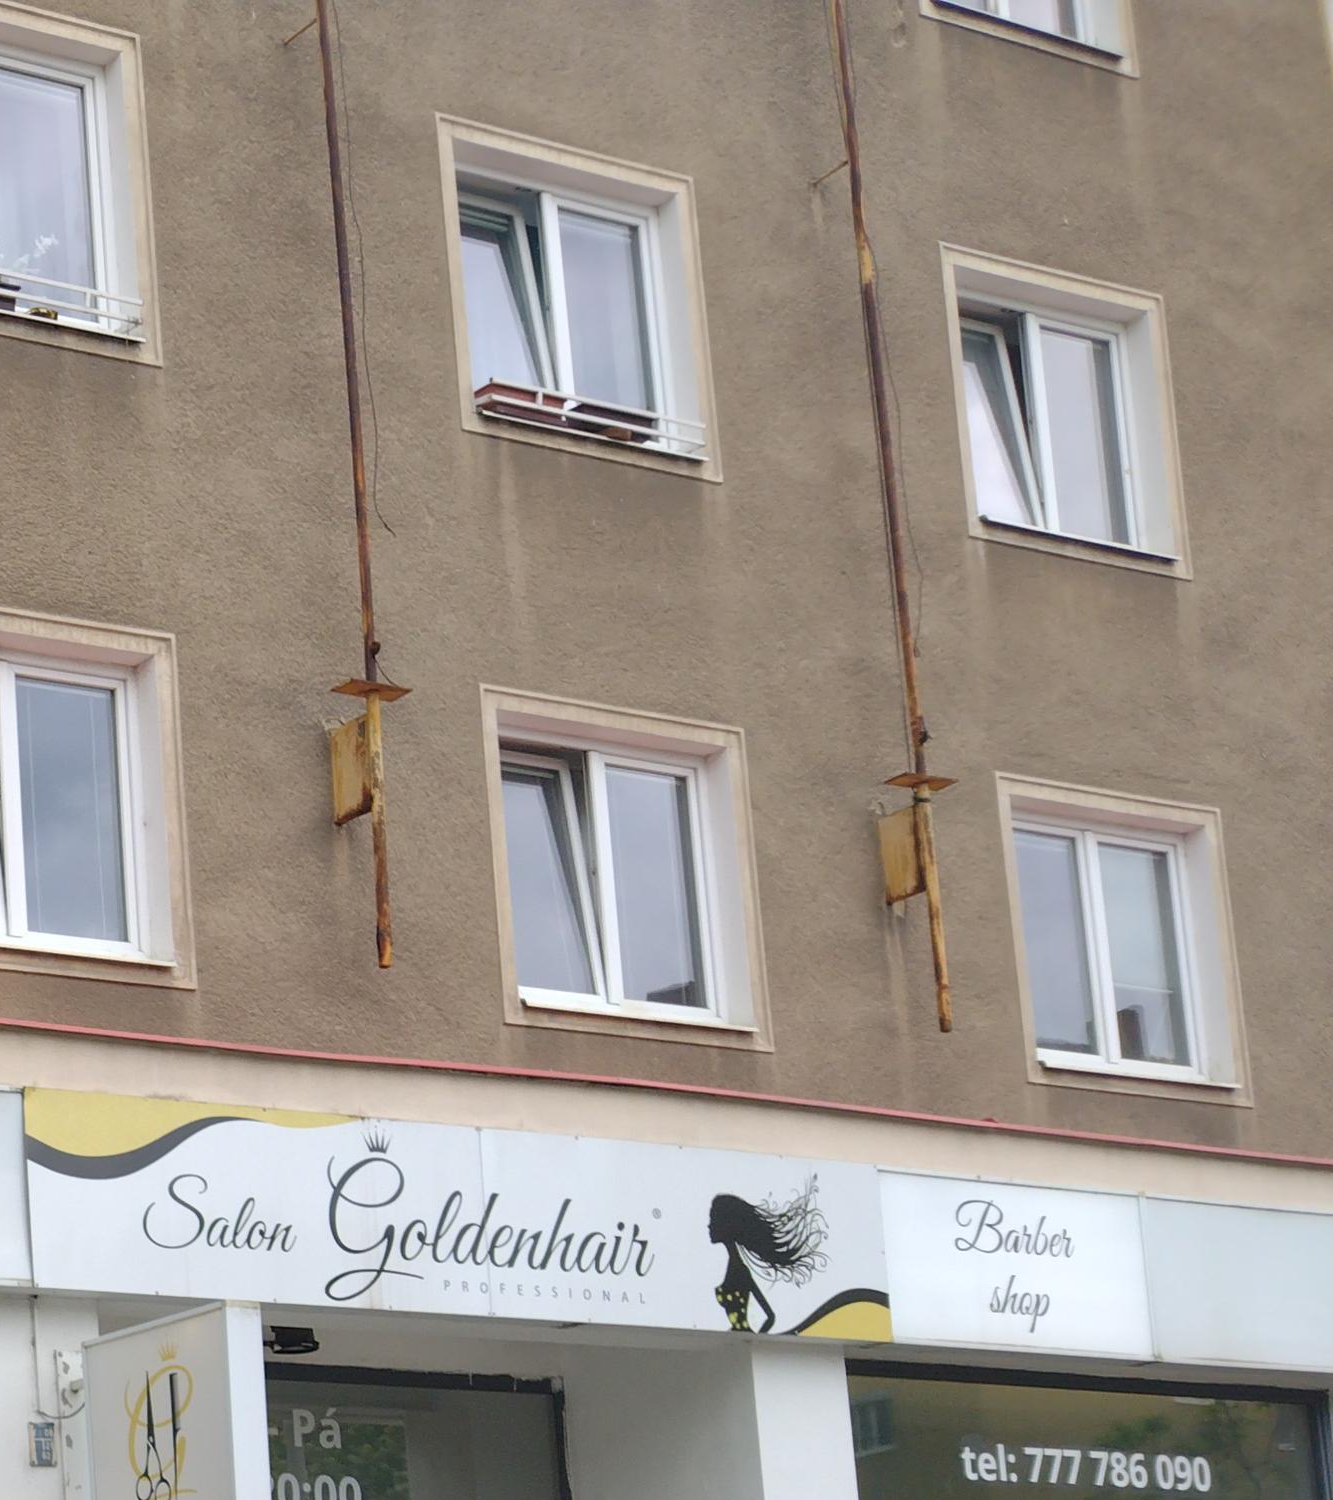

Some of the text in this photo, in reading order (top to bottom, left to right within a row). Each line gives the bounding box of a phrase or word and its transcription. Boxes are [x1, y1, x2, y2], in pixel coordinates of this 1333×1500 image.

[142, 1155, 655, 1301] Salon Goldenhair
[954, 1199, 1074, 1259] Barber
[444, 1280, 646, 1305] PROFESSIONAL
[989, 1275, 1051, 1333] shop
[293, 1407, 342, 1449] Pá
[960, 1444, 1211, 1494] tel: 777 786 090
